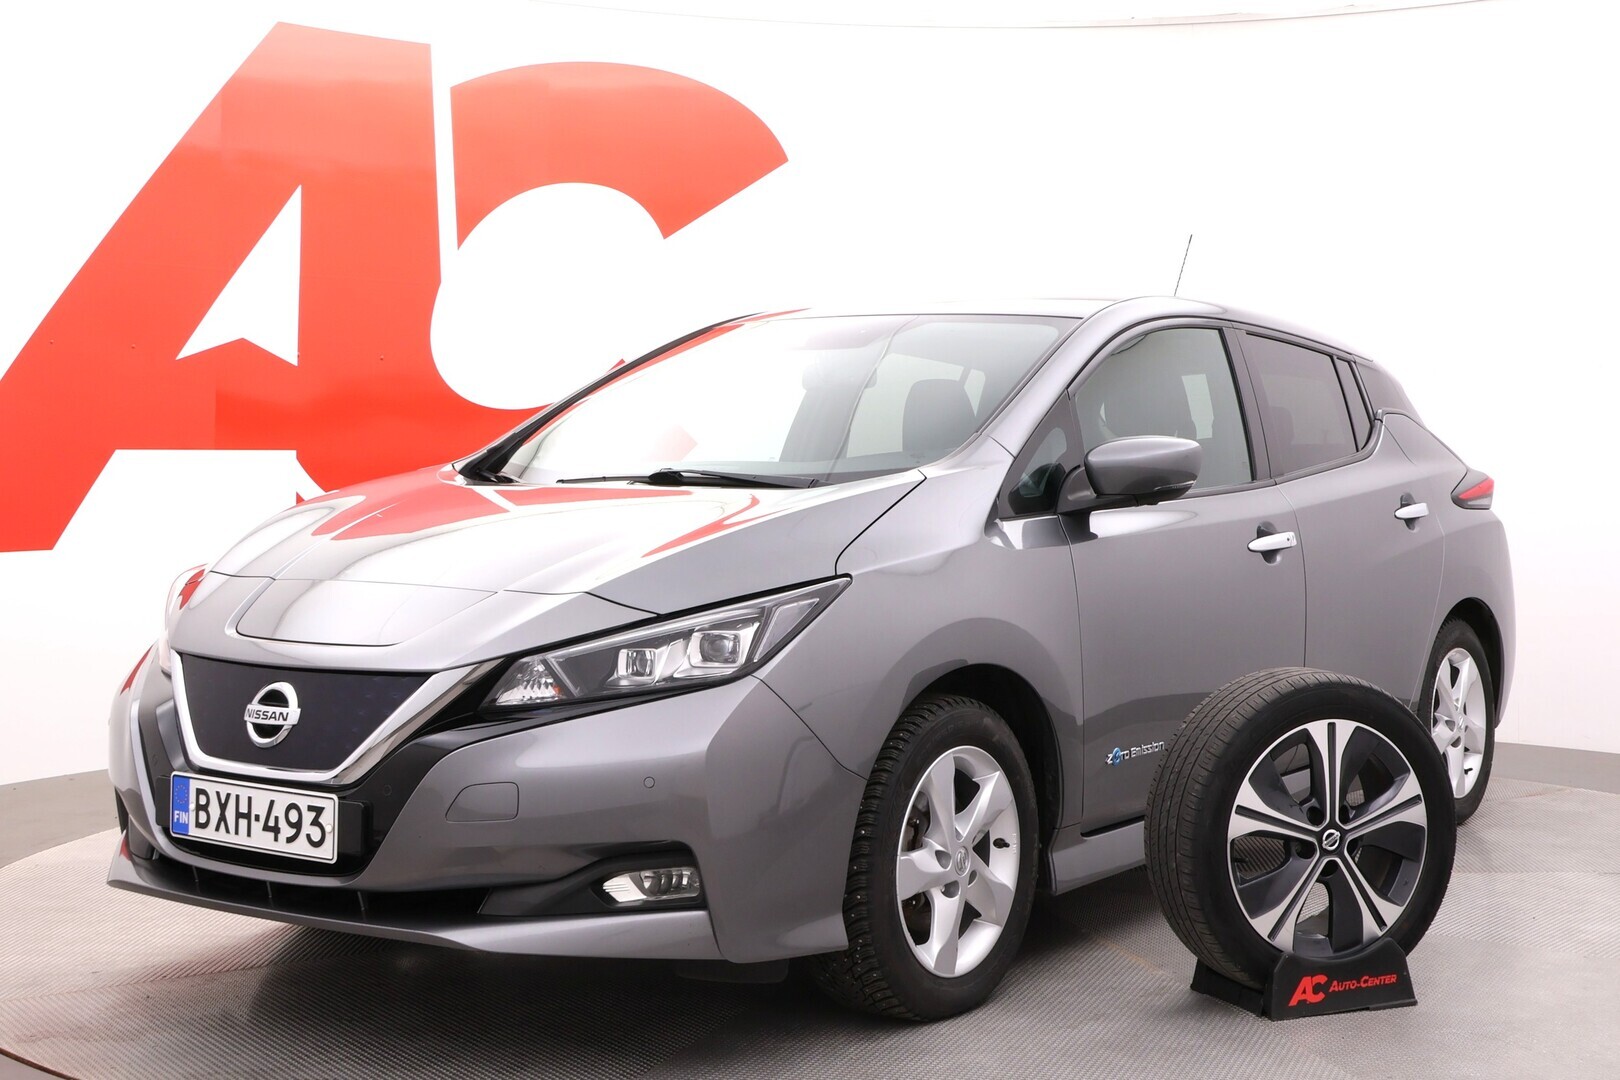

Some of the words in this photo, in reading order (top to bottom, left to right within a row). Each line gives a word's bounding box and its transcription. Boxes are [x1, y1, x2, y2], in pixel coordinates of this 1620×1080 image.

[246, 708, 289, 722] NISSAN
[1130, 741, 1165, 758] Emission
[174, 810, 189, 825] FIN
[194, 787, 327, 849] BXH-493
[1288, 974, 1328, 1007] AC
